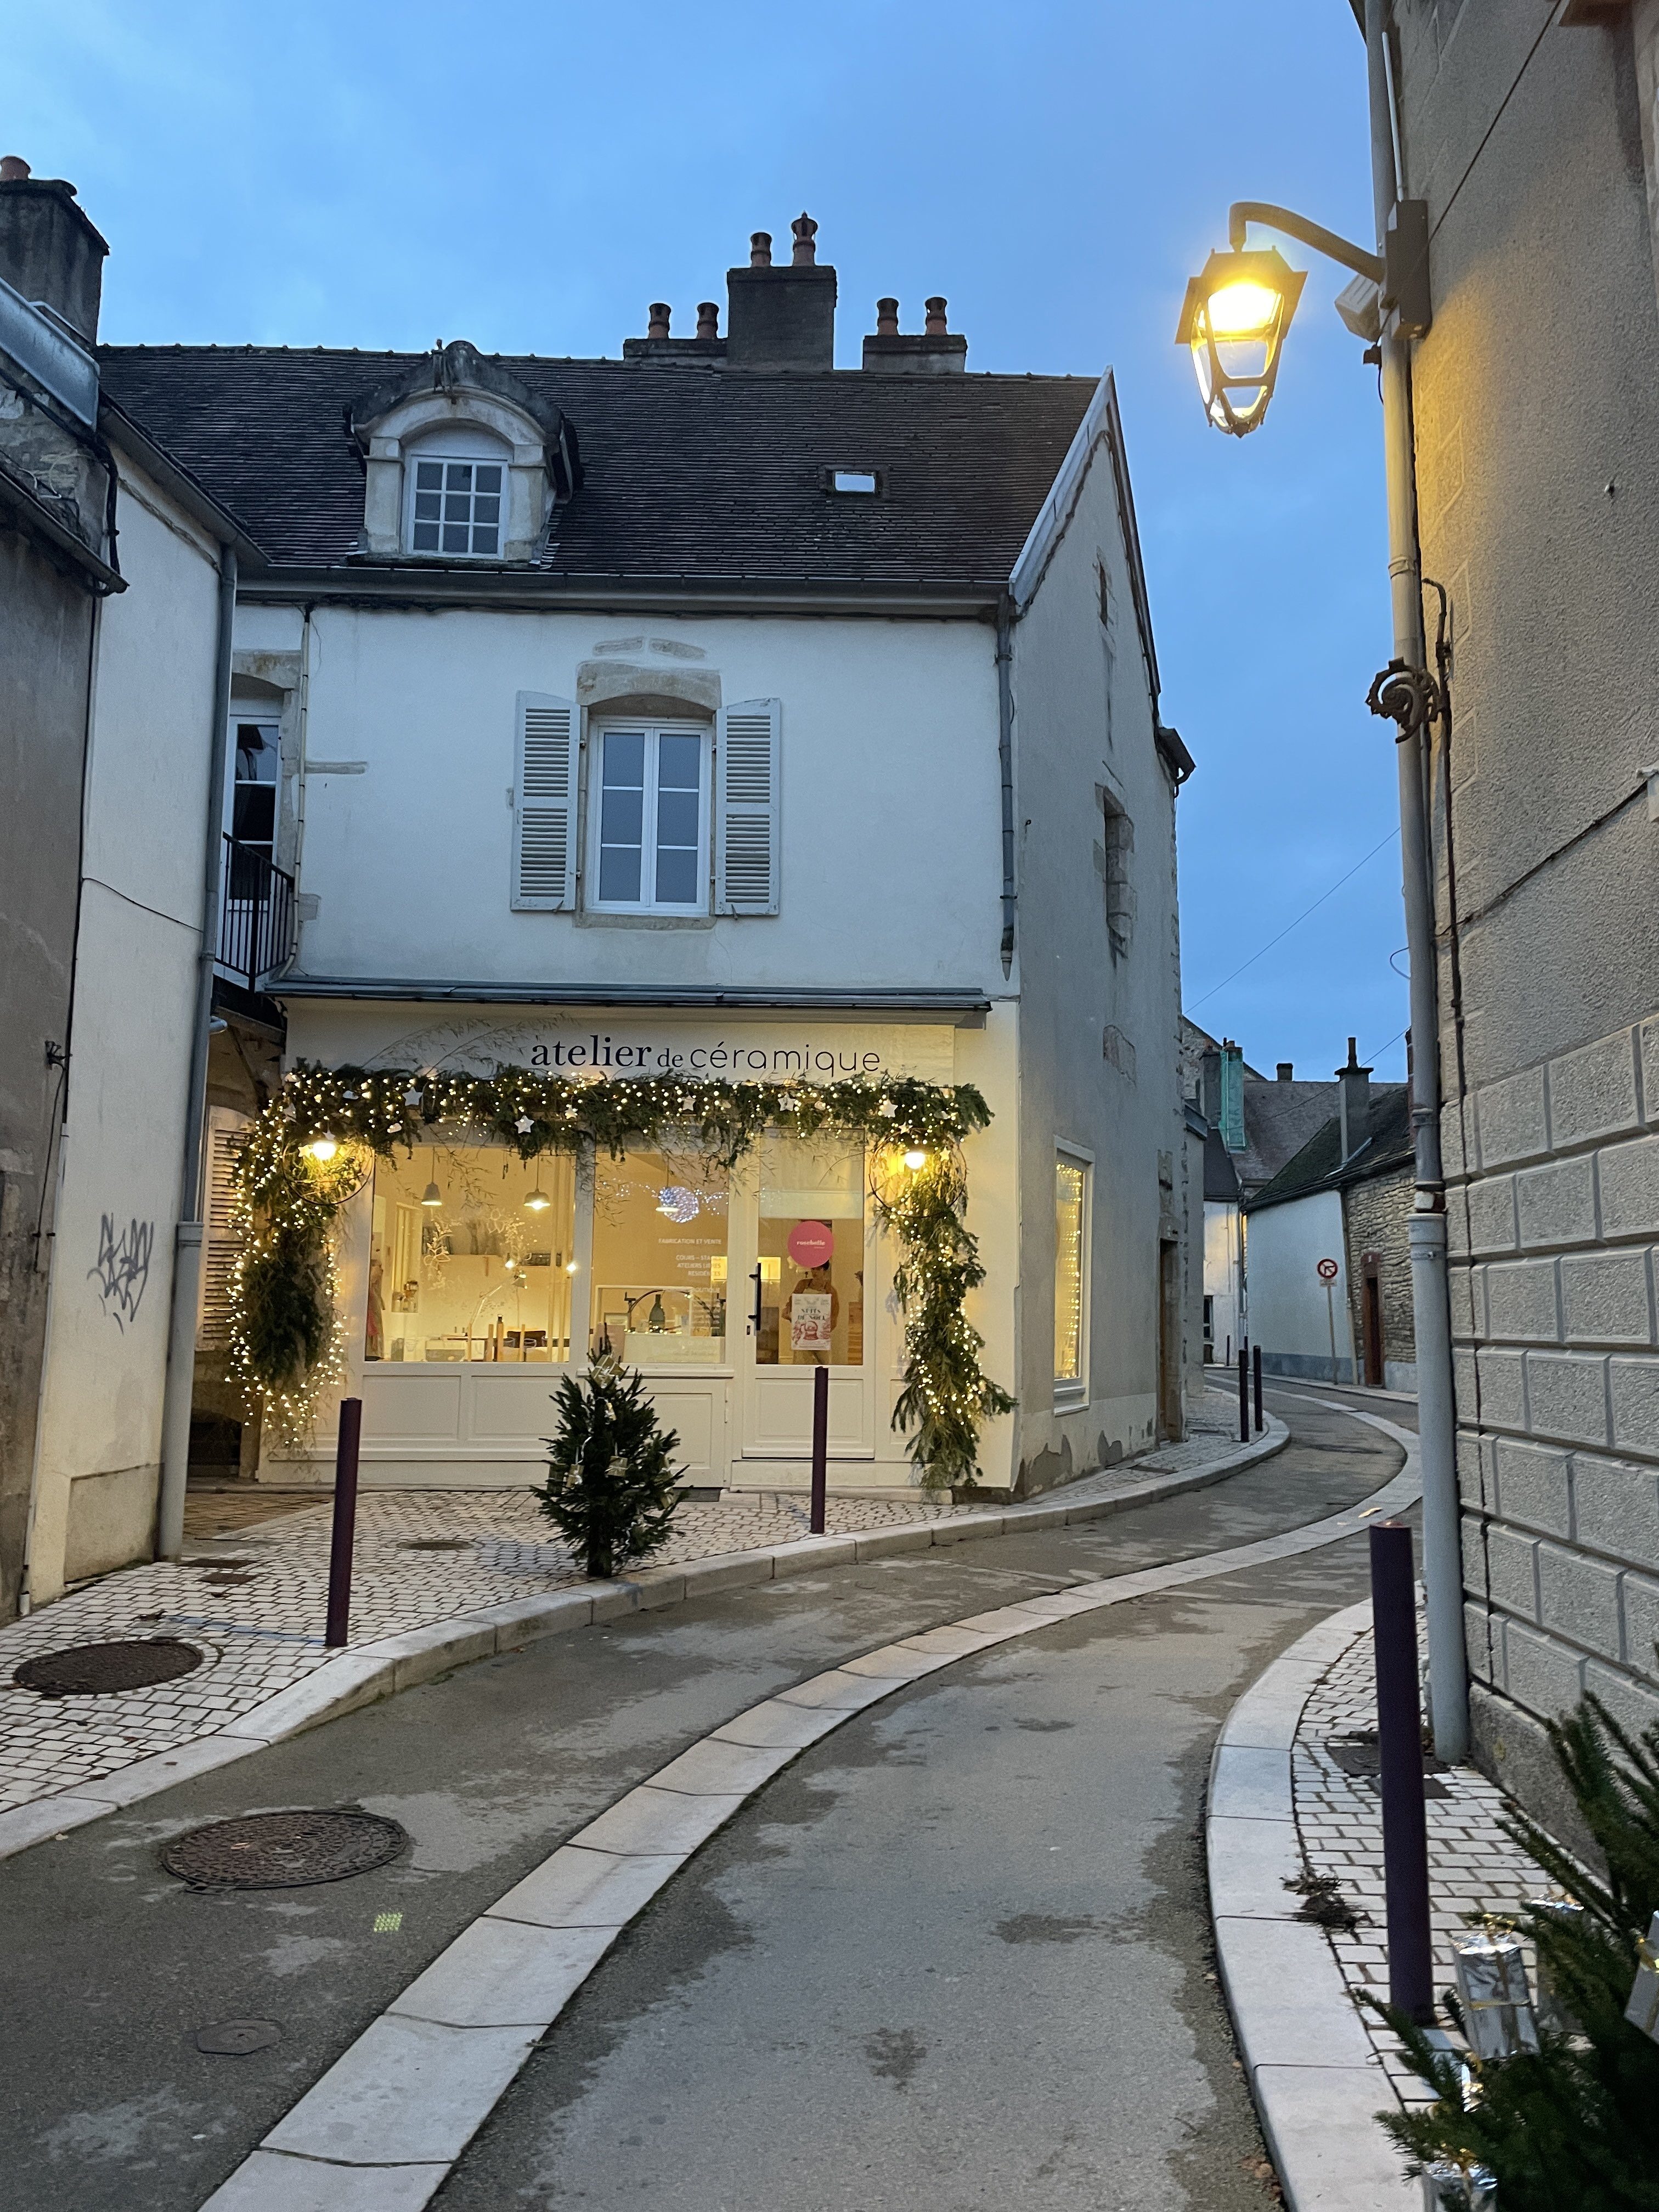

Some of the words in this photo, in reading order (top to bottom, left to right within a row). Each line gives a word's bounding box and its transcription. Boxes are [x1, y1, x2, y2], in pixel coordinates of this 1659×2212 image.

[531, 1035, 652, 1066] atelier
[657, 1048, 684, 1068] de
[690, 1041, 880, 1078] céramique
